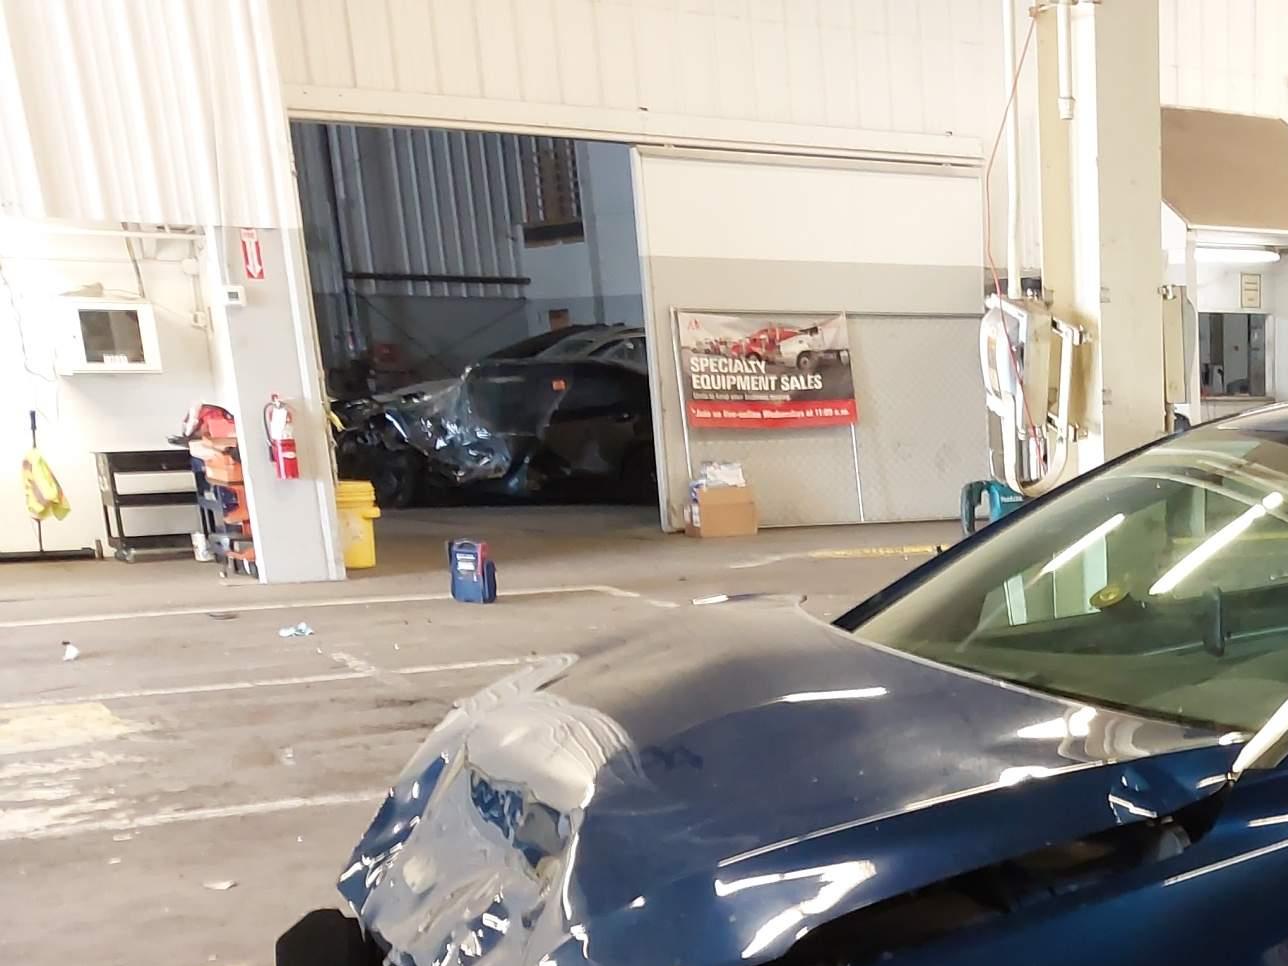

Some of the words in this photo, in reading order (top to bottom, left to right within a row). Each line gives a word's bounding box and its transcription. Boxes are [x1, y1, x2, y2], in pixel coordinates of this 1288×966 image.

[690, 356, 766, 374] SPECIALTY
[691, 374, 779, 391] EQUIPMENT
[780, 374, 823, 391] SALES
